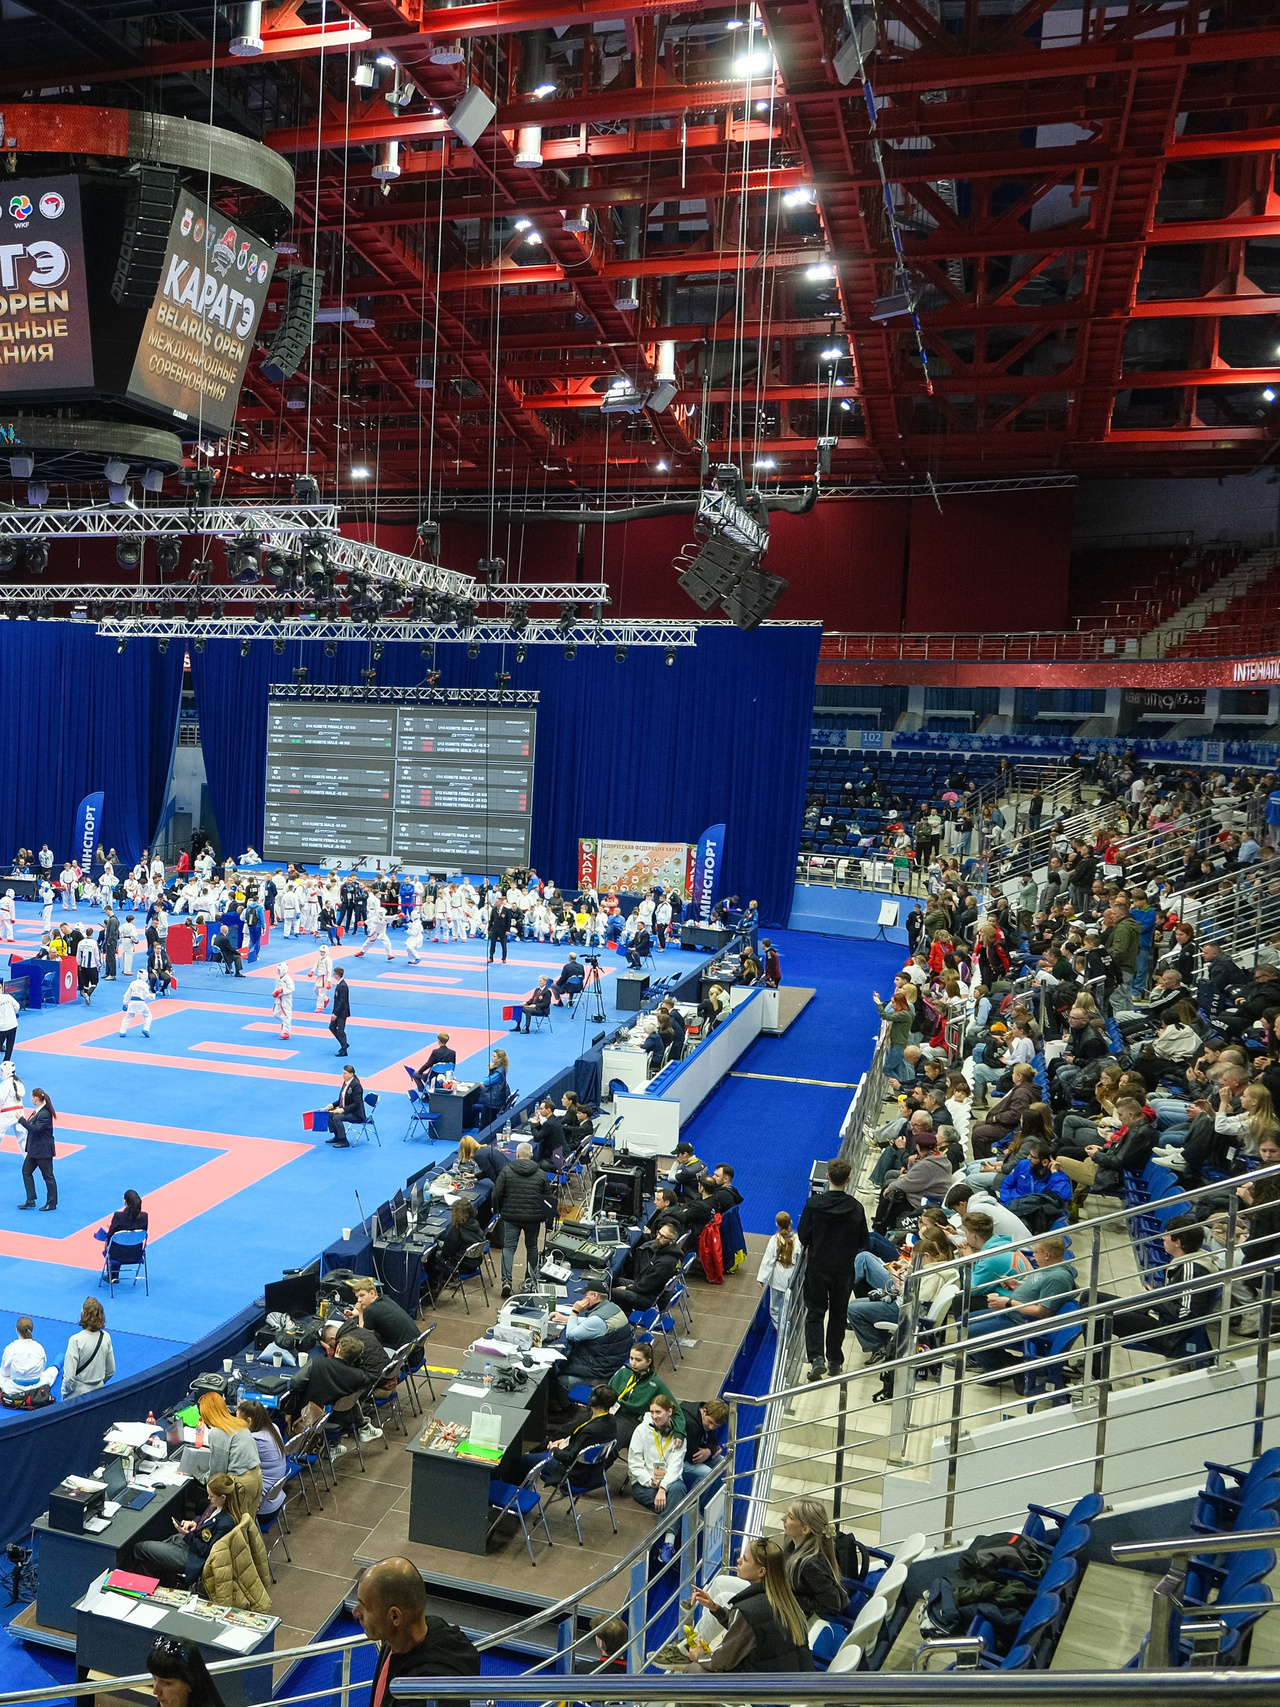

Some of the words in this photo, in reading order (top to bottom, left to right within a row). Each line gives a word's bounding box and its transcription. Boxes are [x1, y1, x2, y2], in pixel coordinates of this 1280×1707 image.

[164, 254, 255, 338] КАРАТЭ
[148, 328, 238, 384] МЕЖДУНАРОДНЫЕ
[156, 303, 213, 346] BELARUS
[214, 332, 245, 363] OPEN
[149, 355, 226, 400] СОРЕВНОВАНИЯ
[863, 733, 881, 742] 102
[81, 805, 96, 874] МІНСПОРТ
[376, 860, 381, 870] 1
[700, 840, 716, 918] МІНСПОРТ
